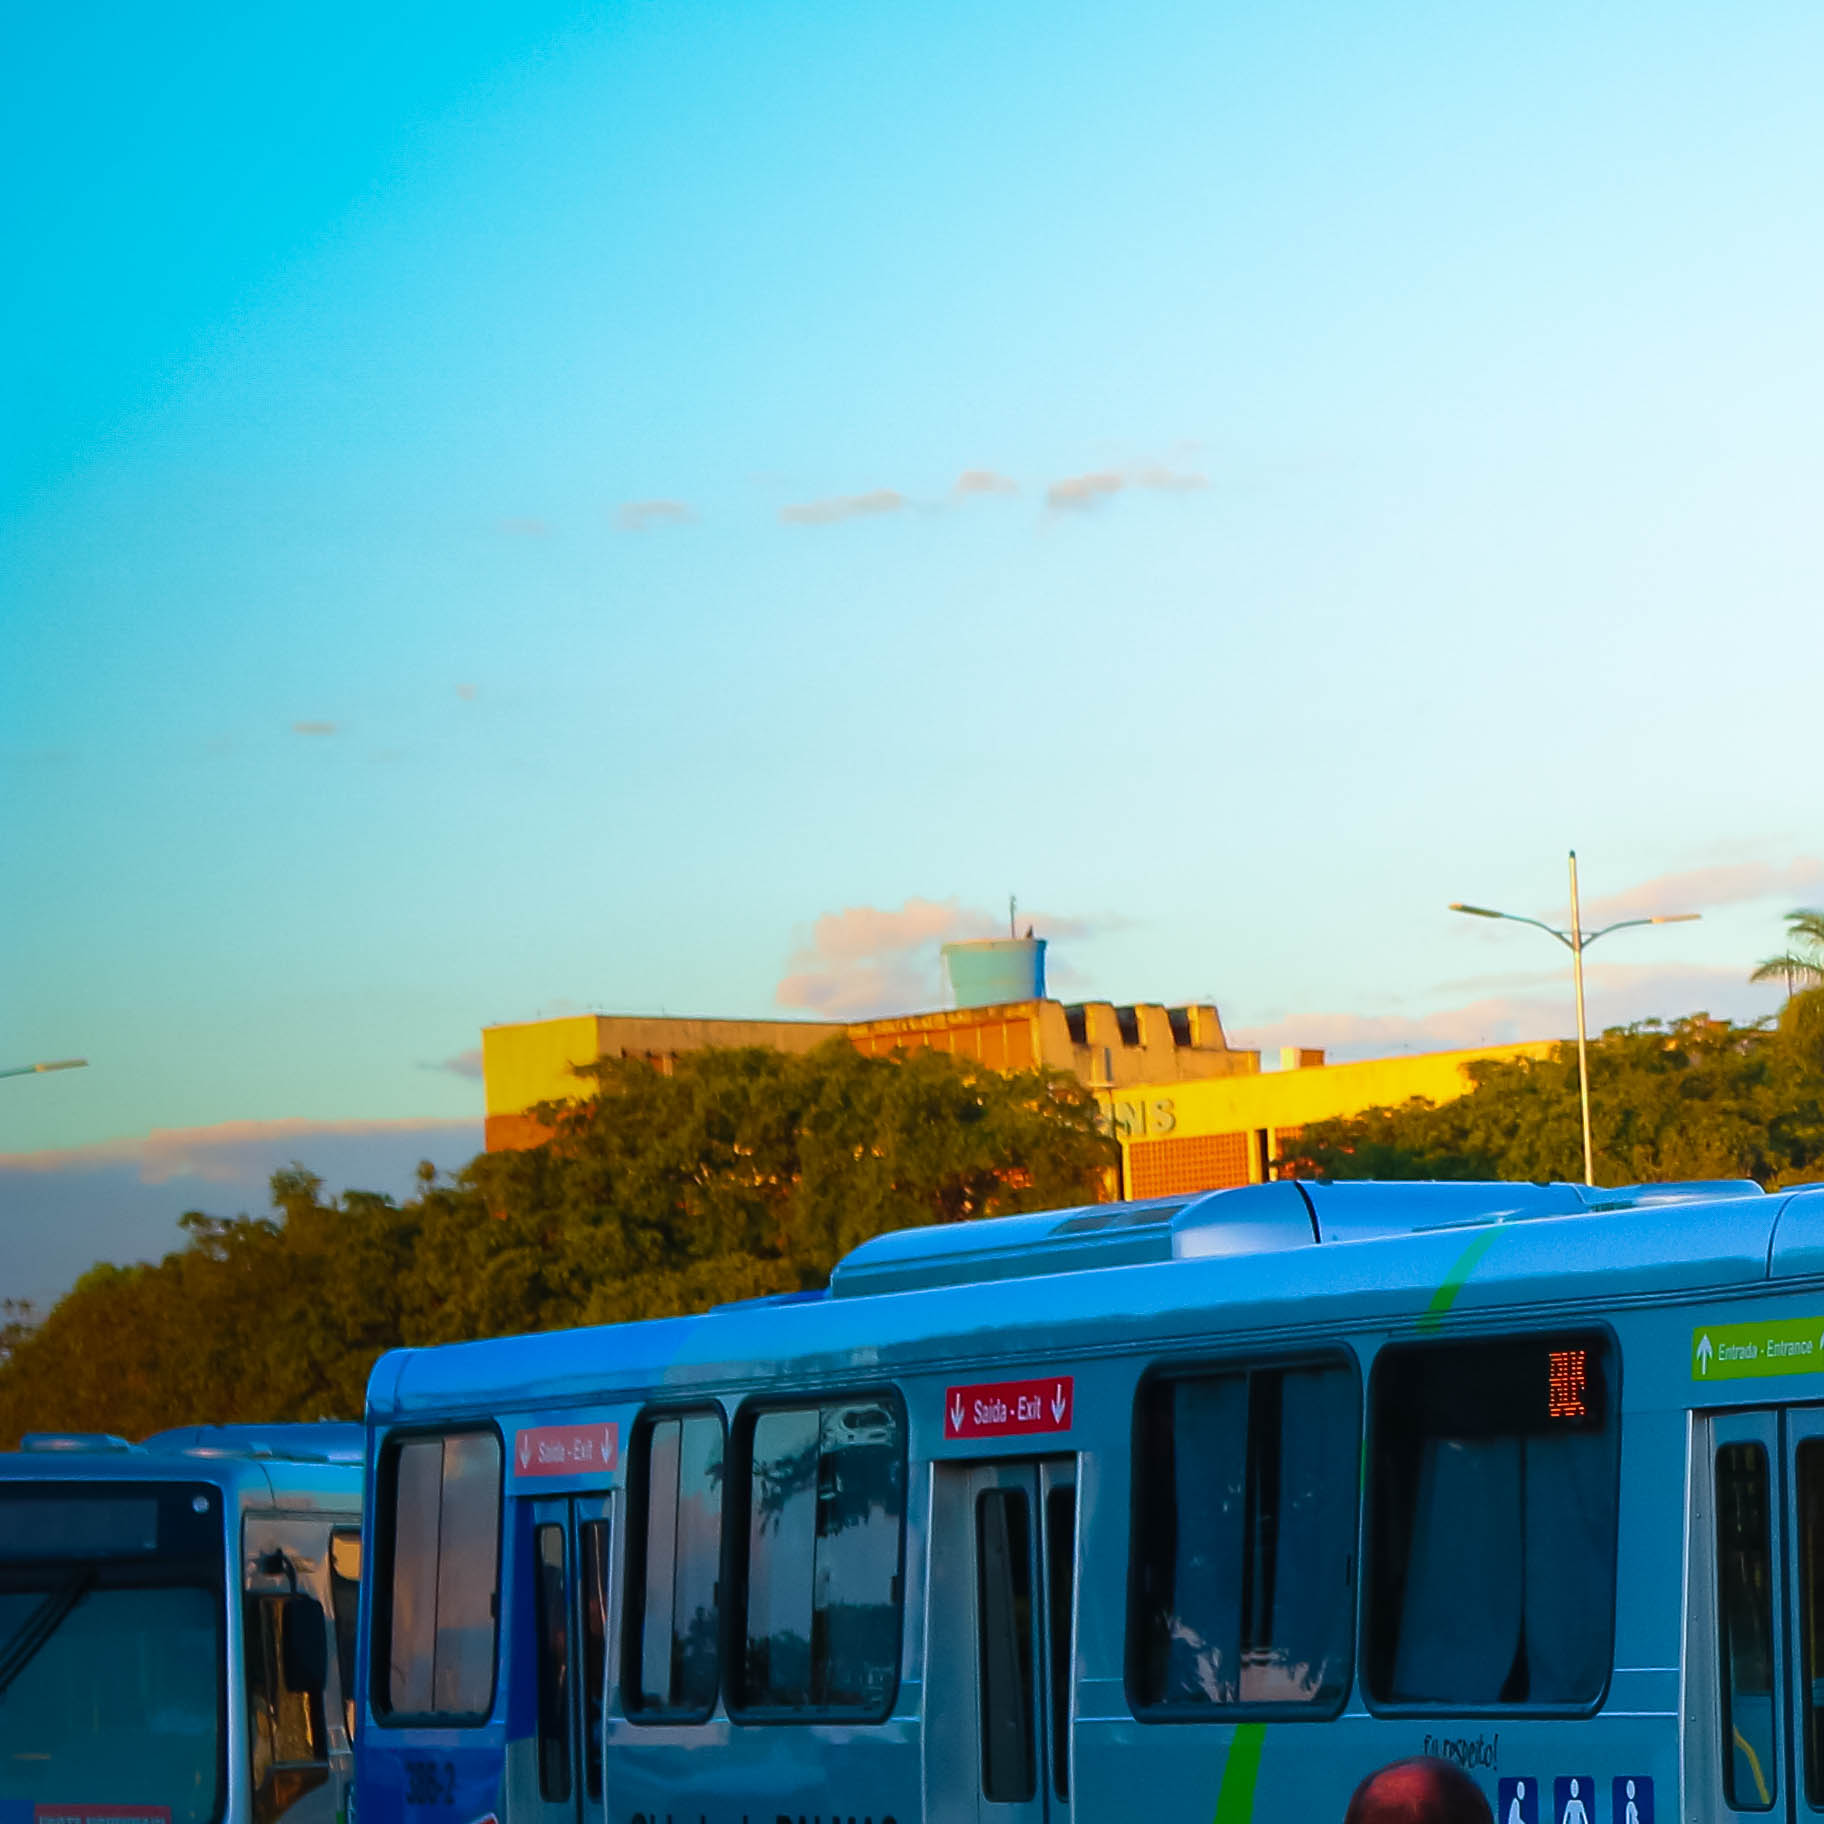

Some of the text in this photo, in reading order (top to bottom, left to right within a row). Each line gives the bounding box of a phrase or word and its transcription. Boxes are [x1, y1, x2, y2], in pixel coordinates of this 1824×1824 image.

[1718, 1342, 1758, 1361] Entrada
[1766, 1339, 1813, 1358] Entrance
[1018, 1395, 1041, 1421] Exit
